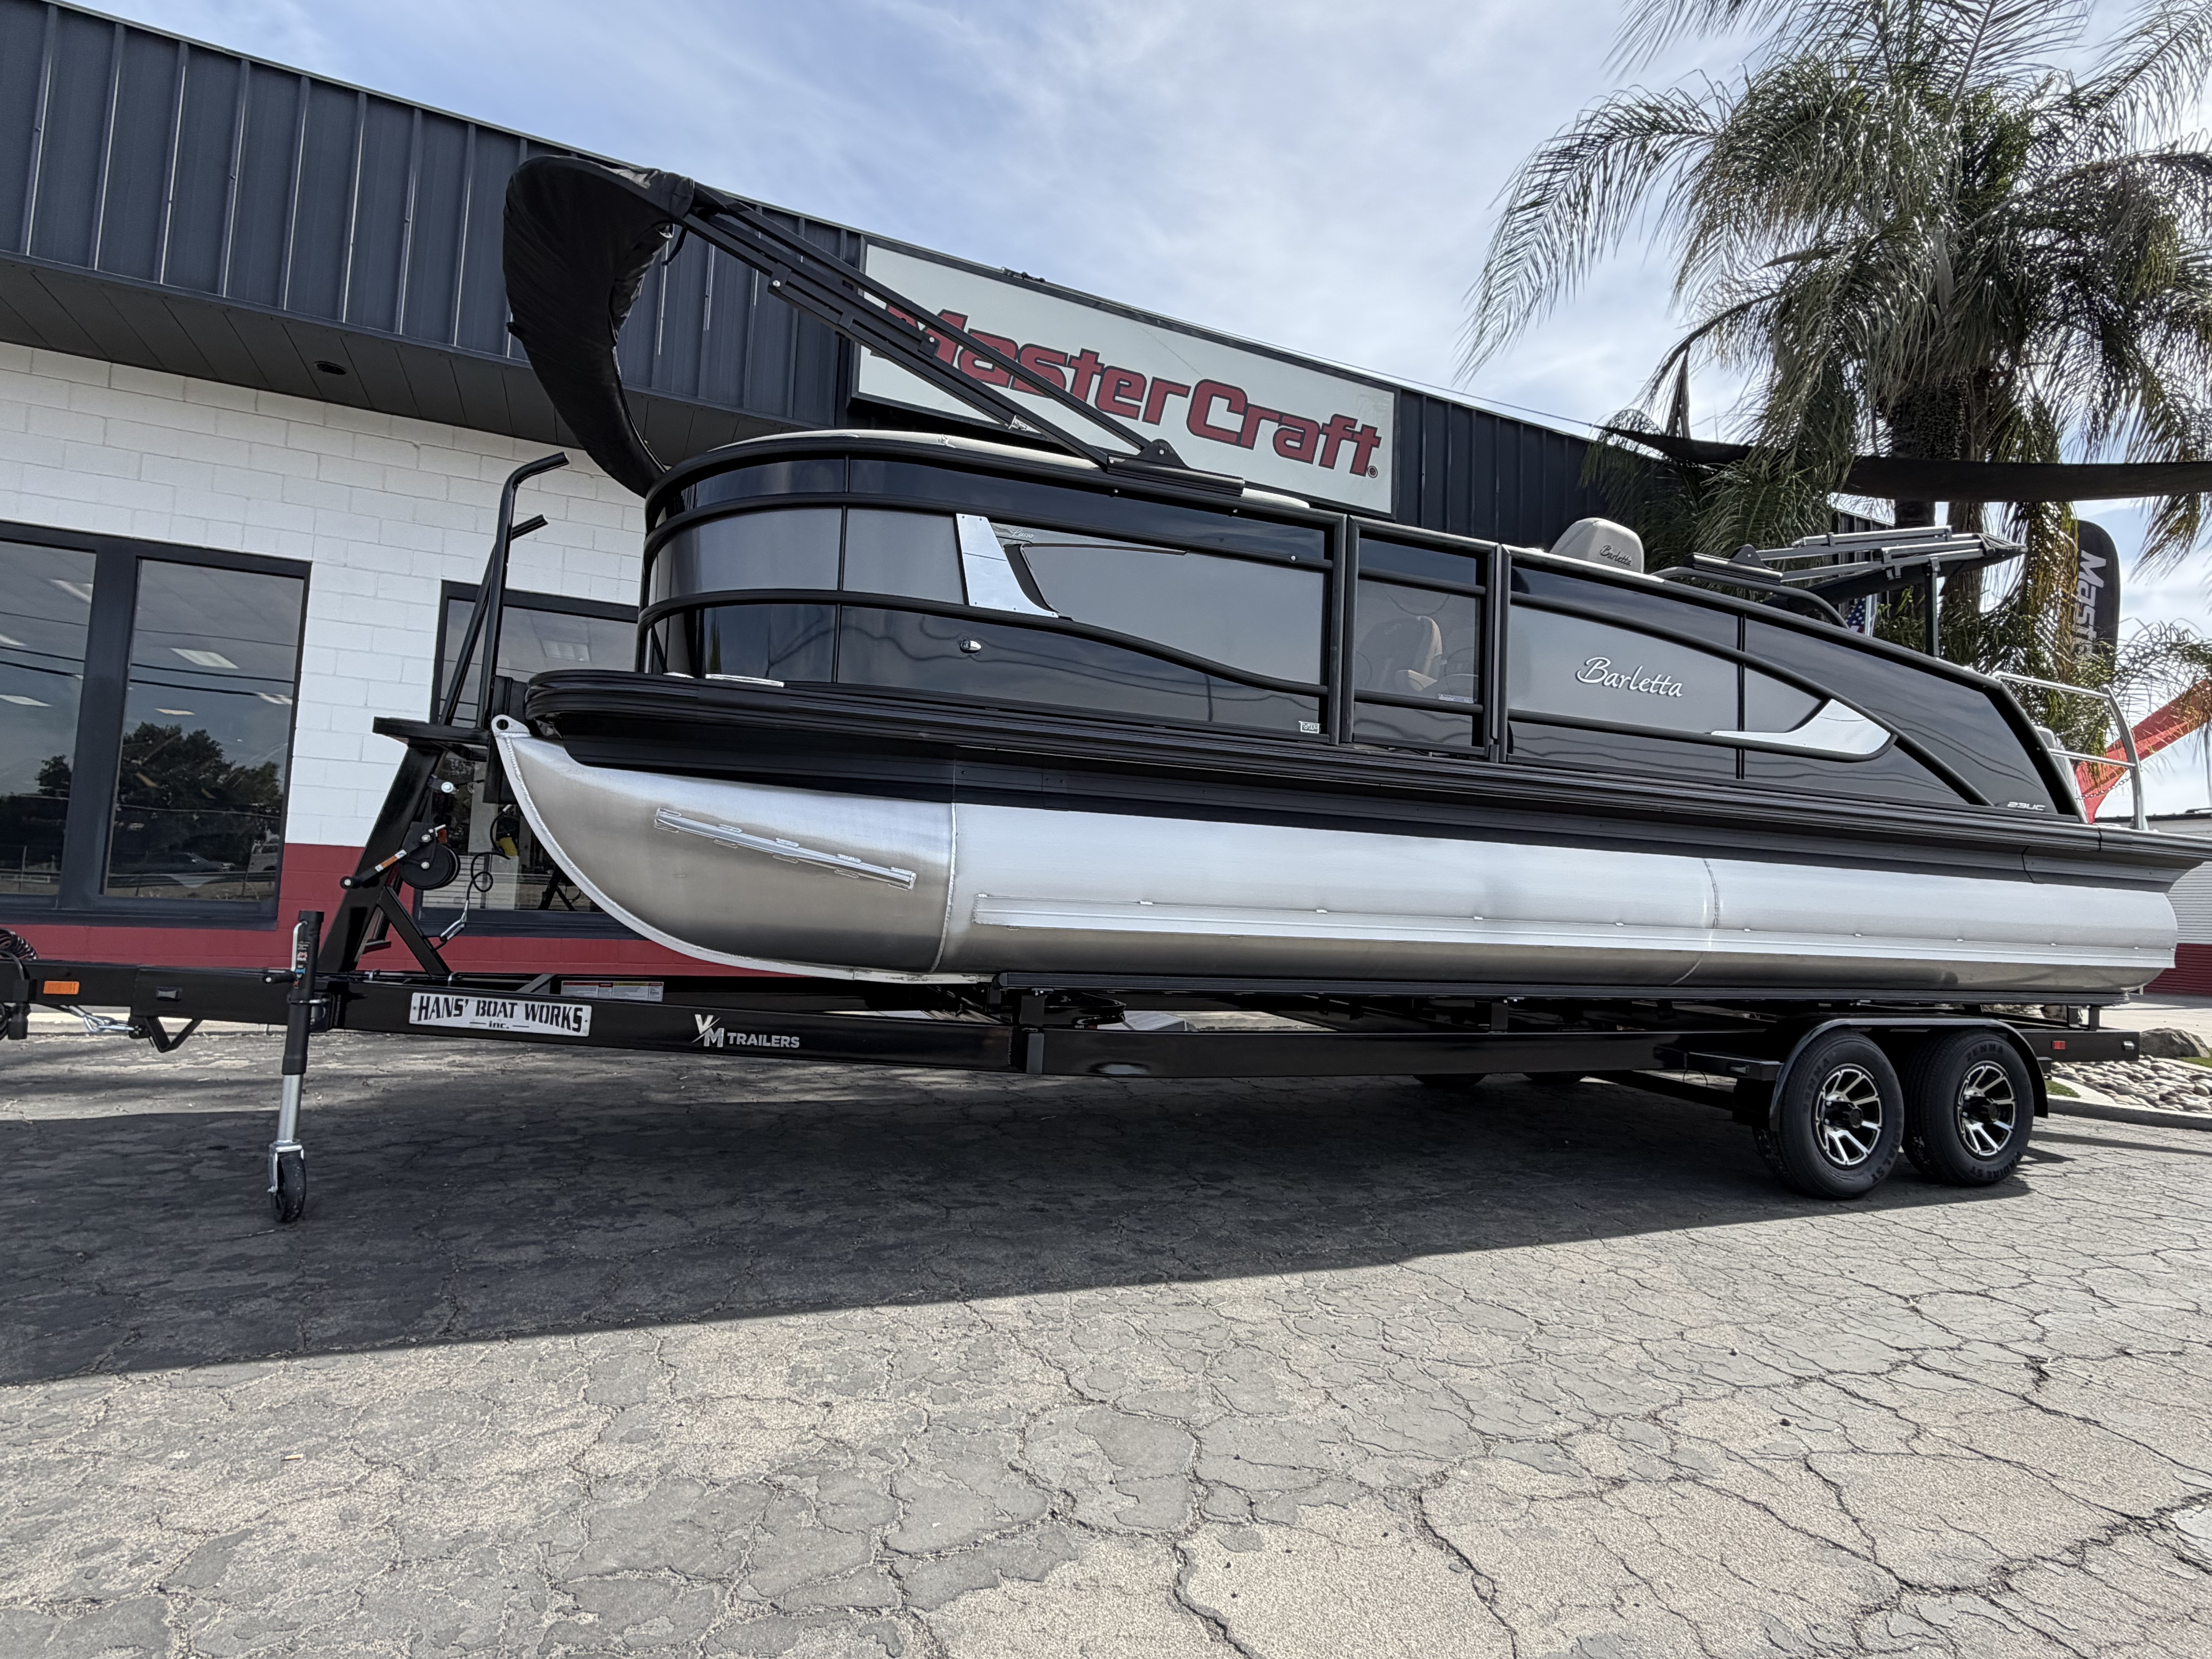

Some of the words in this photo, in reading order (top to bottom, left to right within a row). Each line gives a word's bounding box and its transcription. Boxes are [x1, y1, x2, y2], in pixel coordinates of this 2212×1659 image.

[1599, 544, 1632, 567] Barletta
[1575, 656, 1683, 697] Barletta
[2007, 801, 2046, 811] 23UC
[417, 995, 469, 1021] HANS'
[475, 1000, 518, 1018] BOAT
[524, 1003, 584, 1033] WORKS
[727, 1032, 800, 1049] TRAILERS
